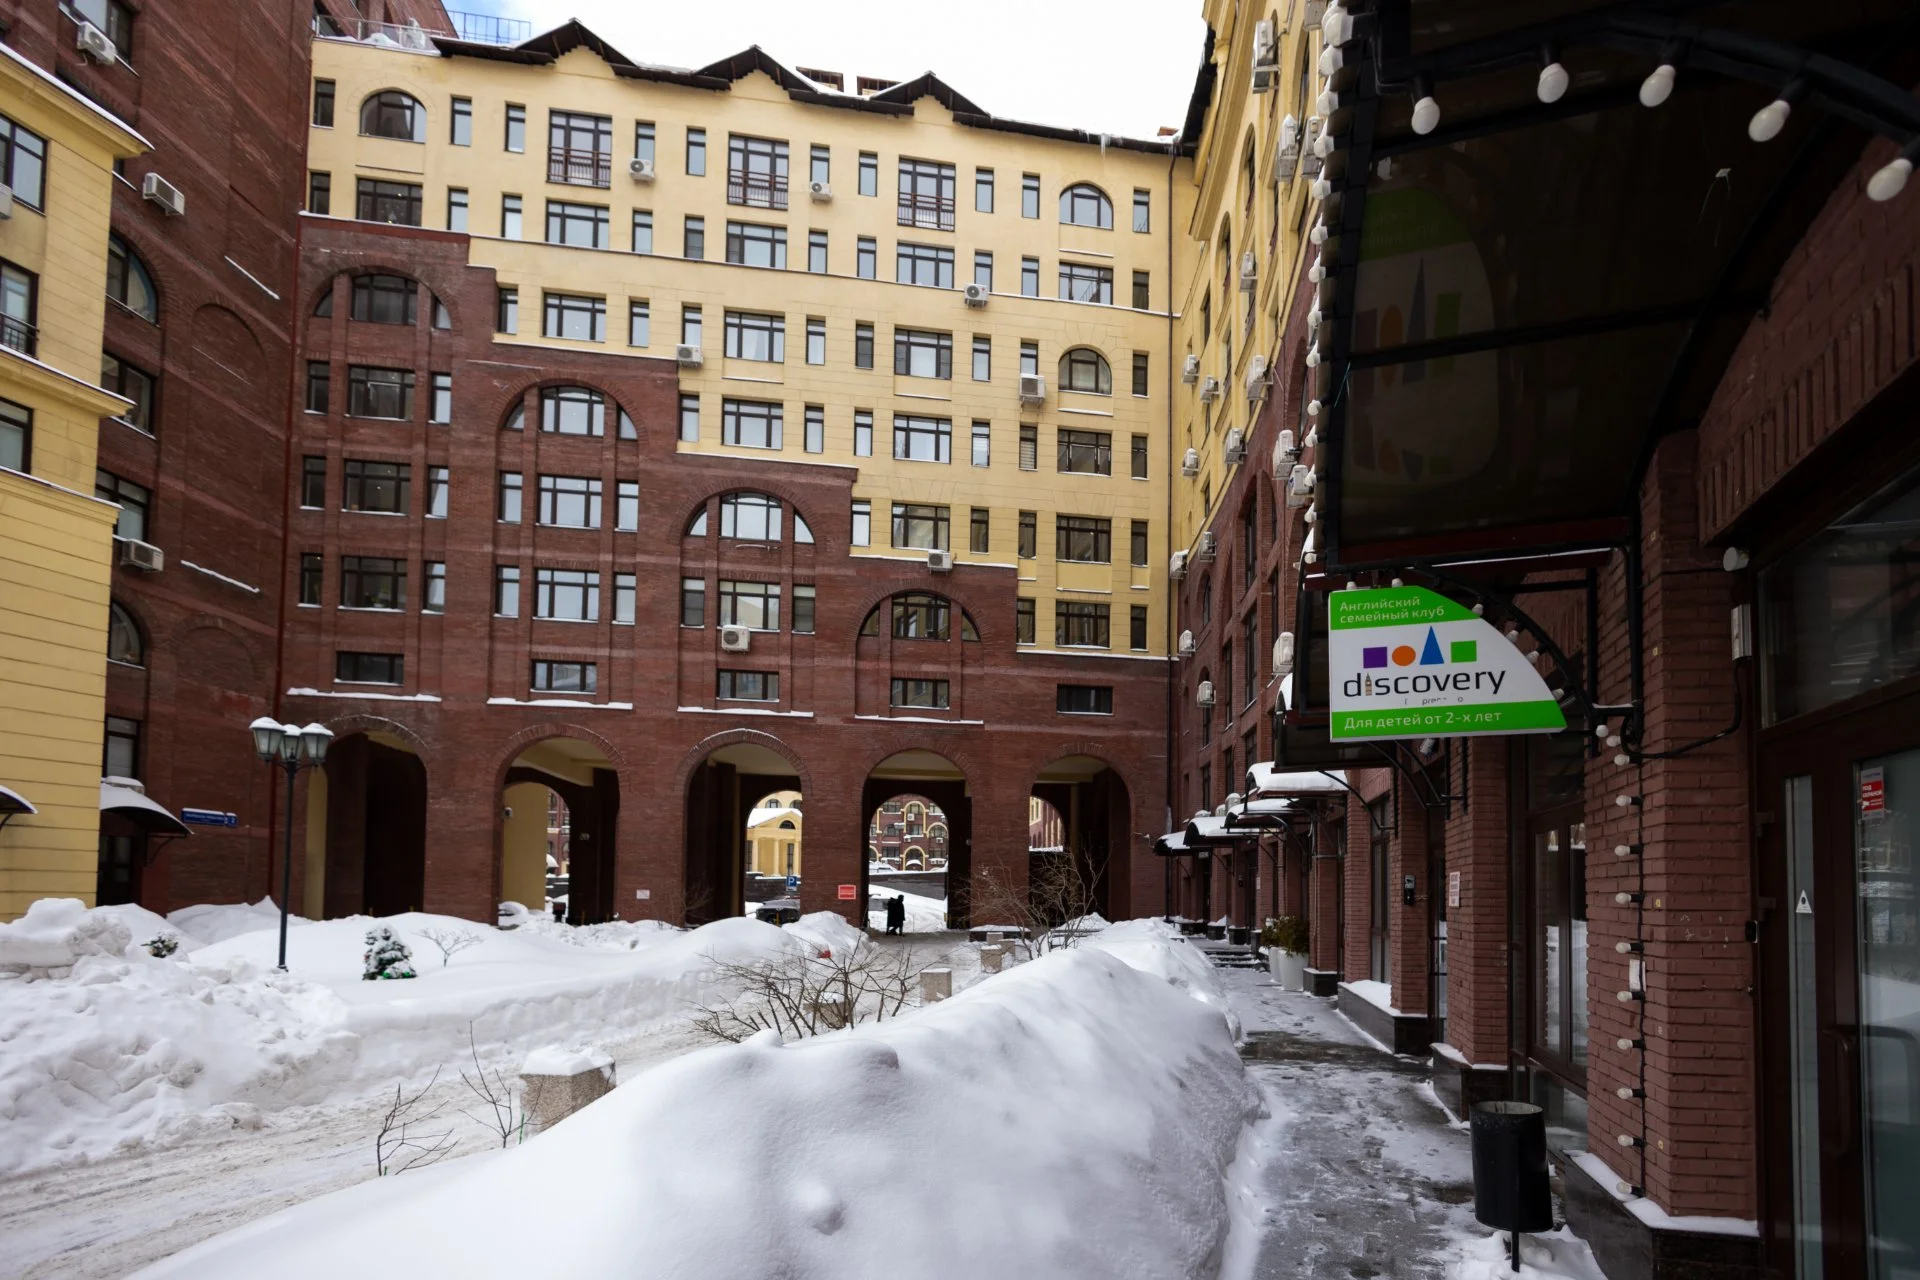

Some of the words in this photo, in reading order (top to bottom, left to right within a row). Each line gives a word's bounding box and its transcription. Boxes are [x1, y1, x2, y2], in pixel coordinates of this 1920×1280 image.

[1339, 596, 1421, 612] Английский
[1340, 611, 1409, 624] семейный
[1412, 605, 1445, 619] клуб
[1343, 670, 1506, 697] discovery
[1344, 716, 1373, 730] Для
[1376, 713, 1421, 728] детей
[1424, 714, 1441, 725] от
[1445, 712, 1471, 724] 2-х
[1474, 711, 1502, 723] лет
